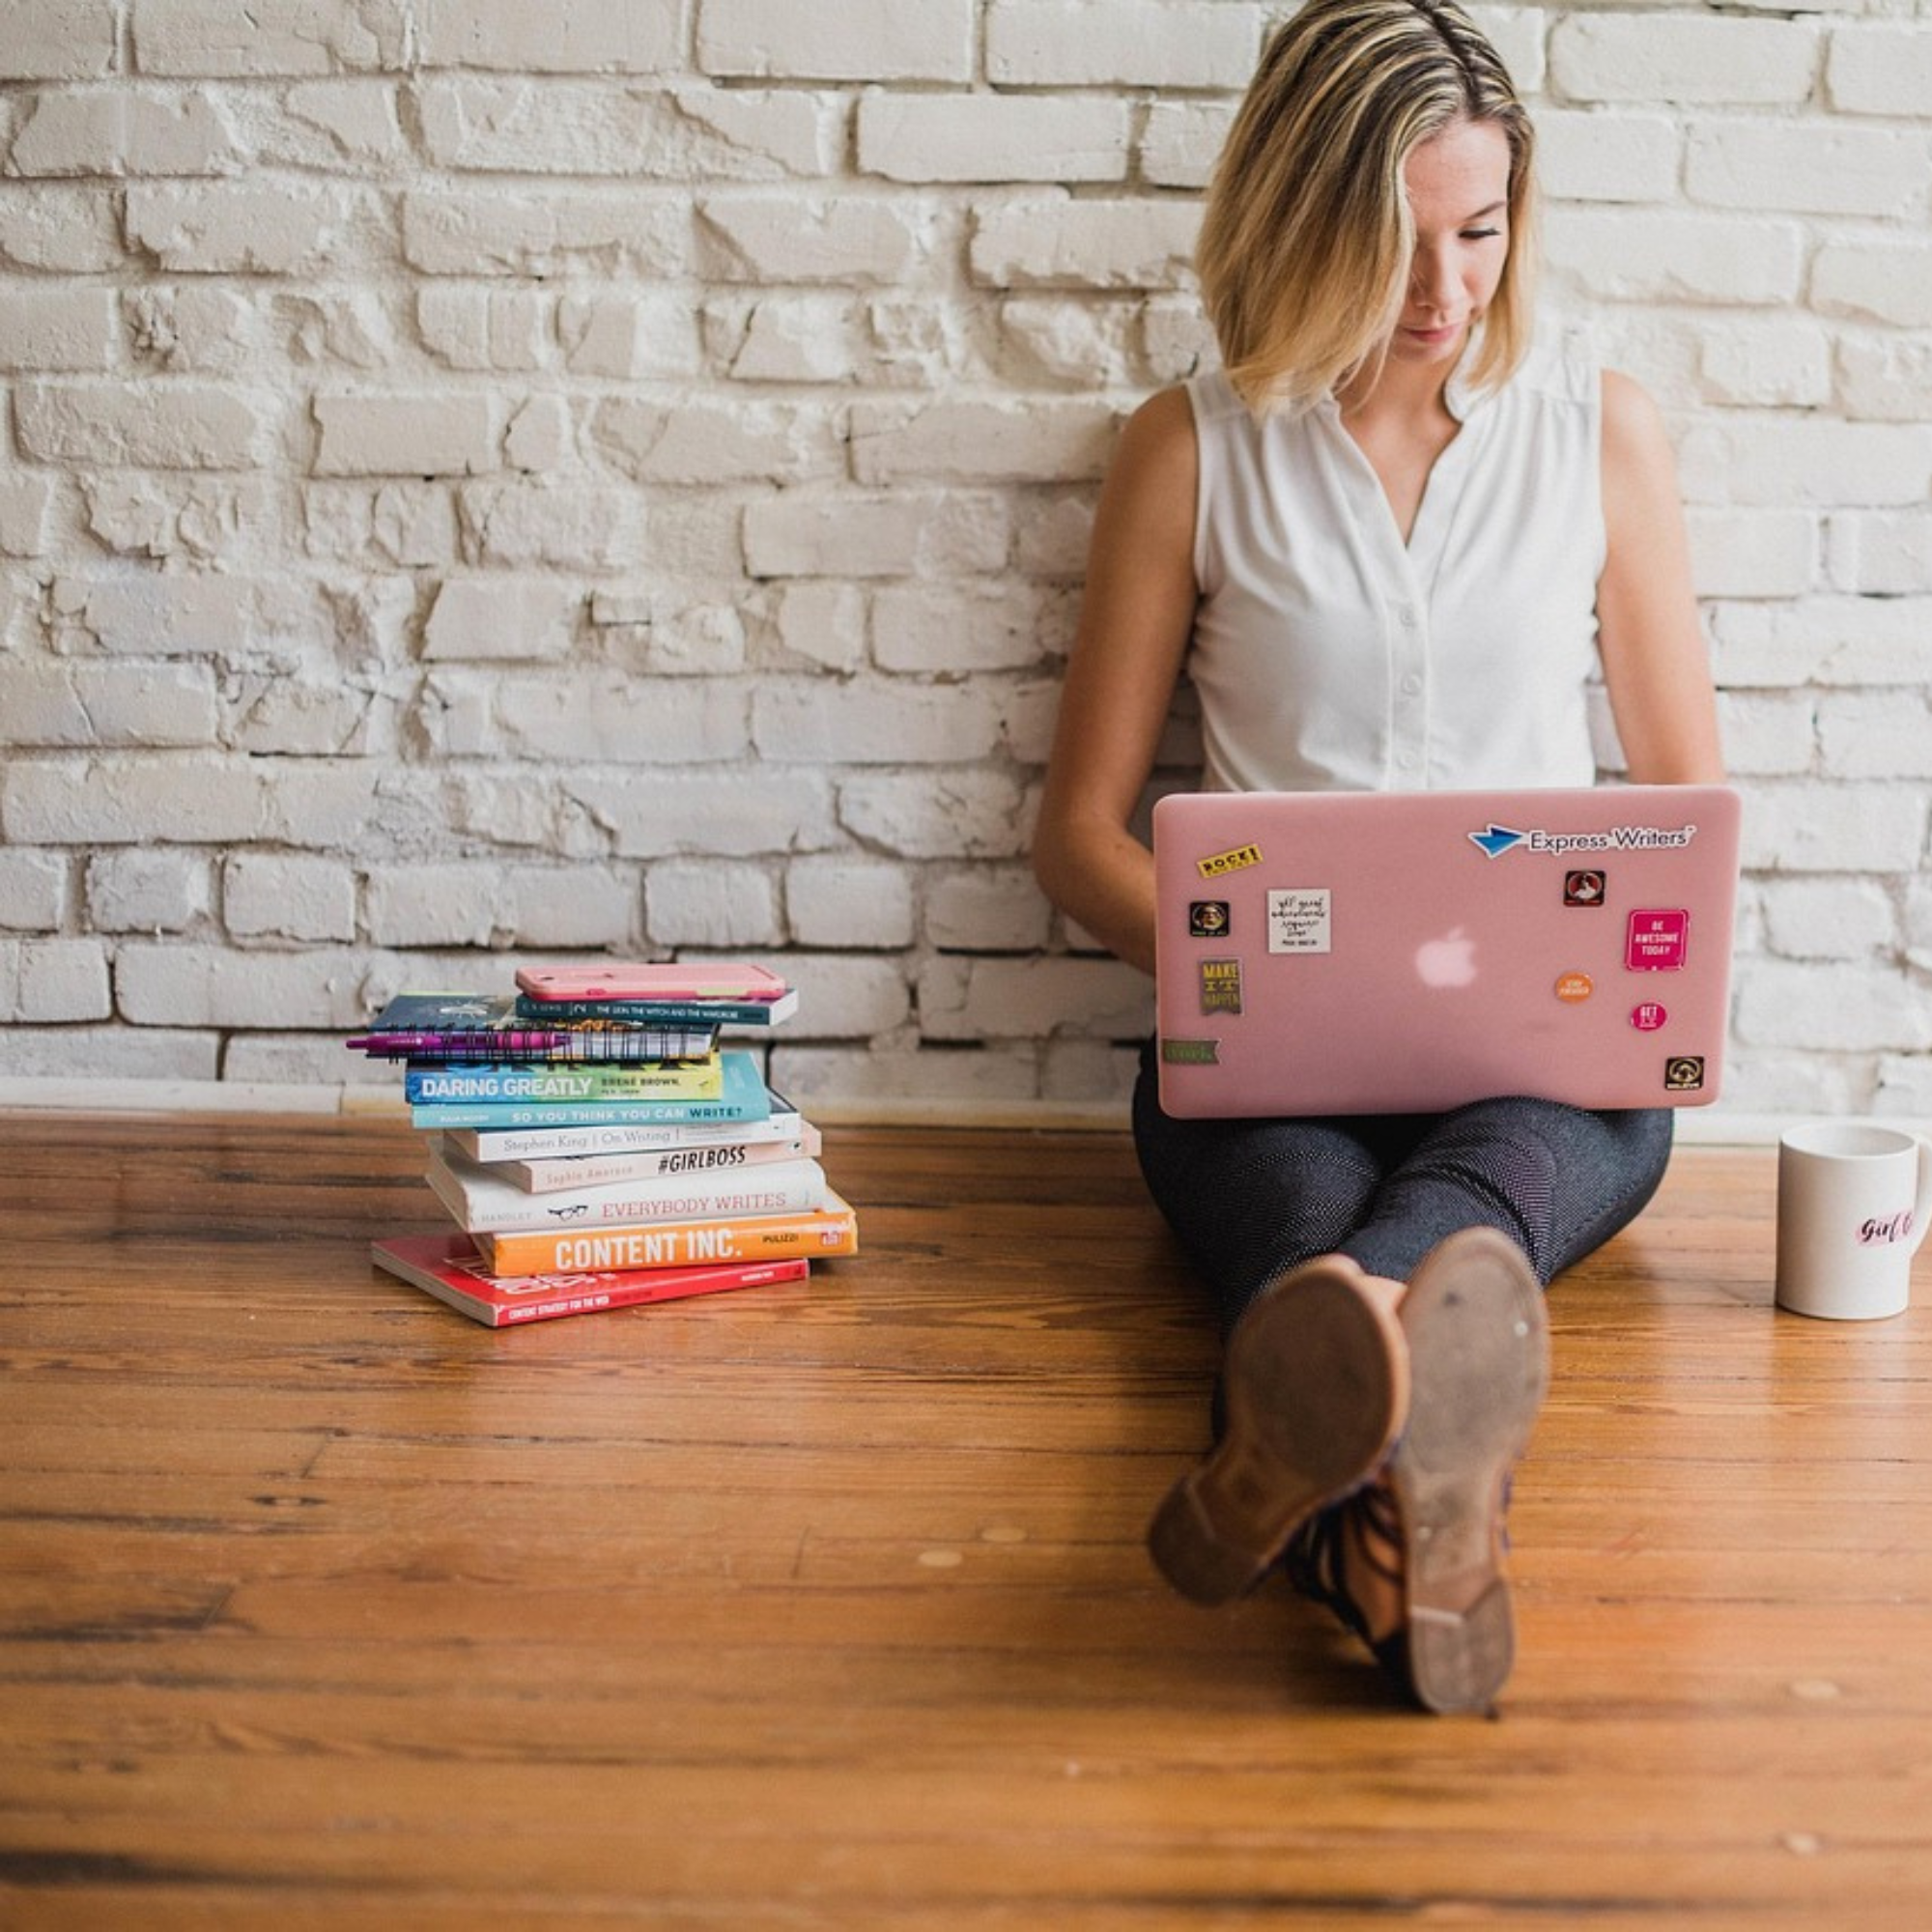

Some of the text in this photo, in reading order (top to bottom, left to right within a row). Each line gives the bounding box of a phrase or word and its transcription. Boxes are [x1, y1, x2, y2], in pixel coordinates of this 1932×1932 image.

[1530, 829, 1687, 853] Express Writers
[1642, 946, 1670, 955] TODAY
[1204, 963, 1238, 978] MAKE
[422, 1077, 592, 1097] DARING GREATLY
[512, 1106, 743, 1123] SO YOU THINK YOU CAN WRITE?
[503, 1139, 555, 1153] Stephen
[557, 1135, 587, 1150] King
[601, 1131, 622, 1144] On
[624, 1129, 671, 1144] Writing
[658, 1146, 746, 1174] #GIRLBOSS
[603, 1198, 711, 1219] EVERYBODY
[715, 1191, 786, 1209] WRITES
[1861, 1212, 1900, 1242] Girl
[555, 1228, 742, 1270] CONTENT INC.
